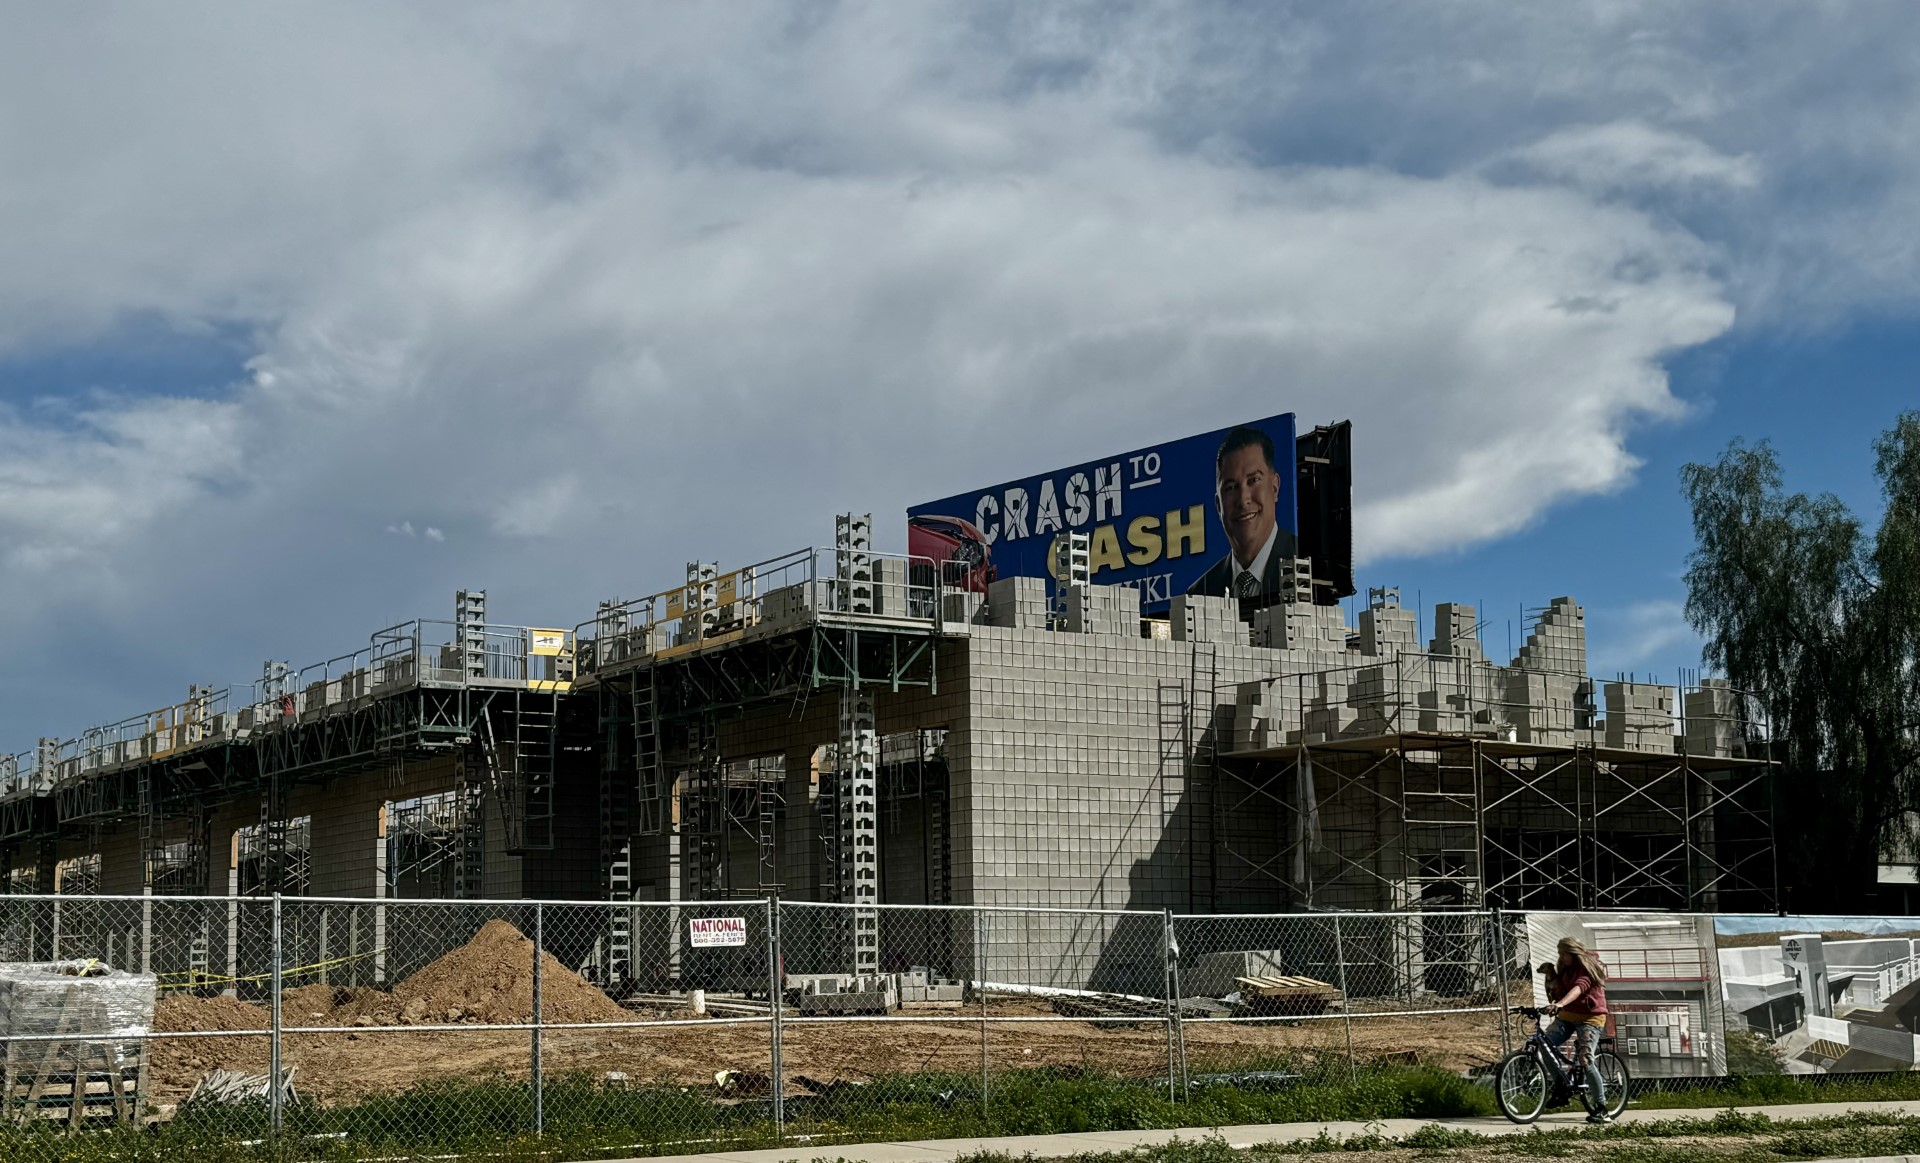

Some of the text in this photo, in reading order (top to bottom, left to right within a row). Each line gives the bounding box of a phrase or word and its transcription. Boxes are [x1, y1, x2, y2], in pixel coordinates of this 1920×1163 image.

[1129, 452, 1161, 479] TO
[976, 462, 1122, 545] CRASH
[692, 919, 745, 933] NATIONAL
